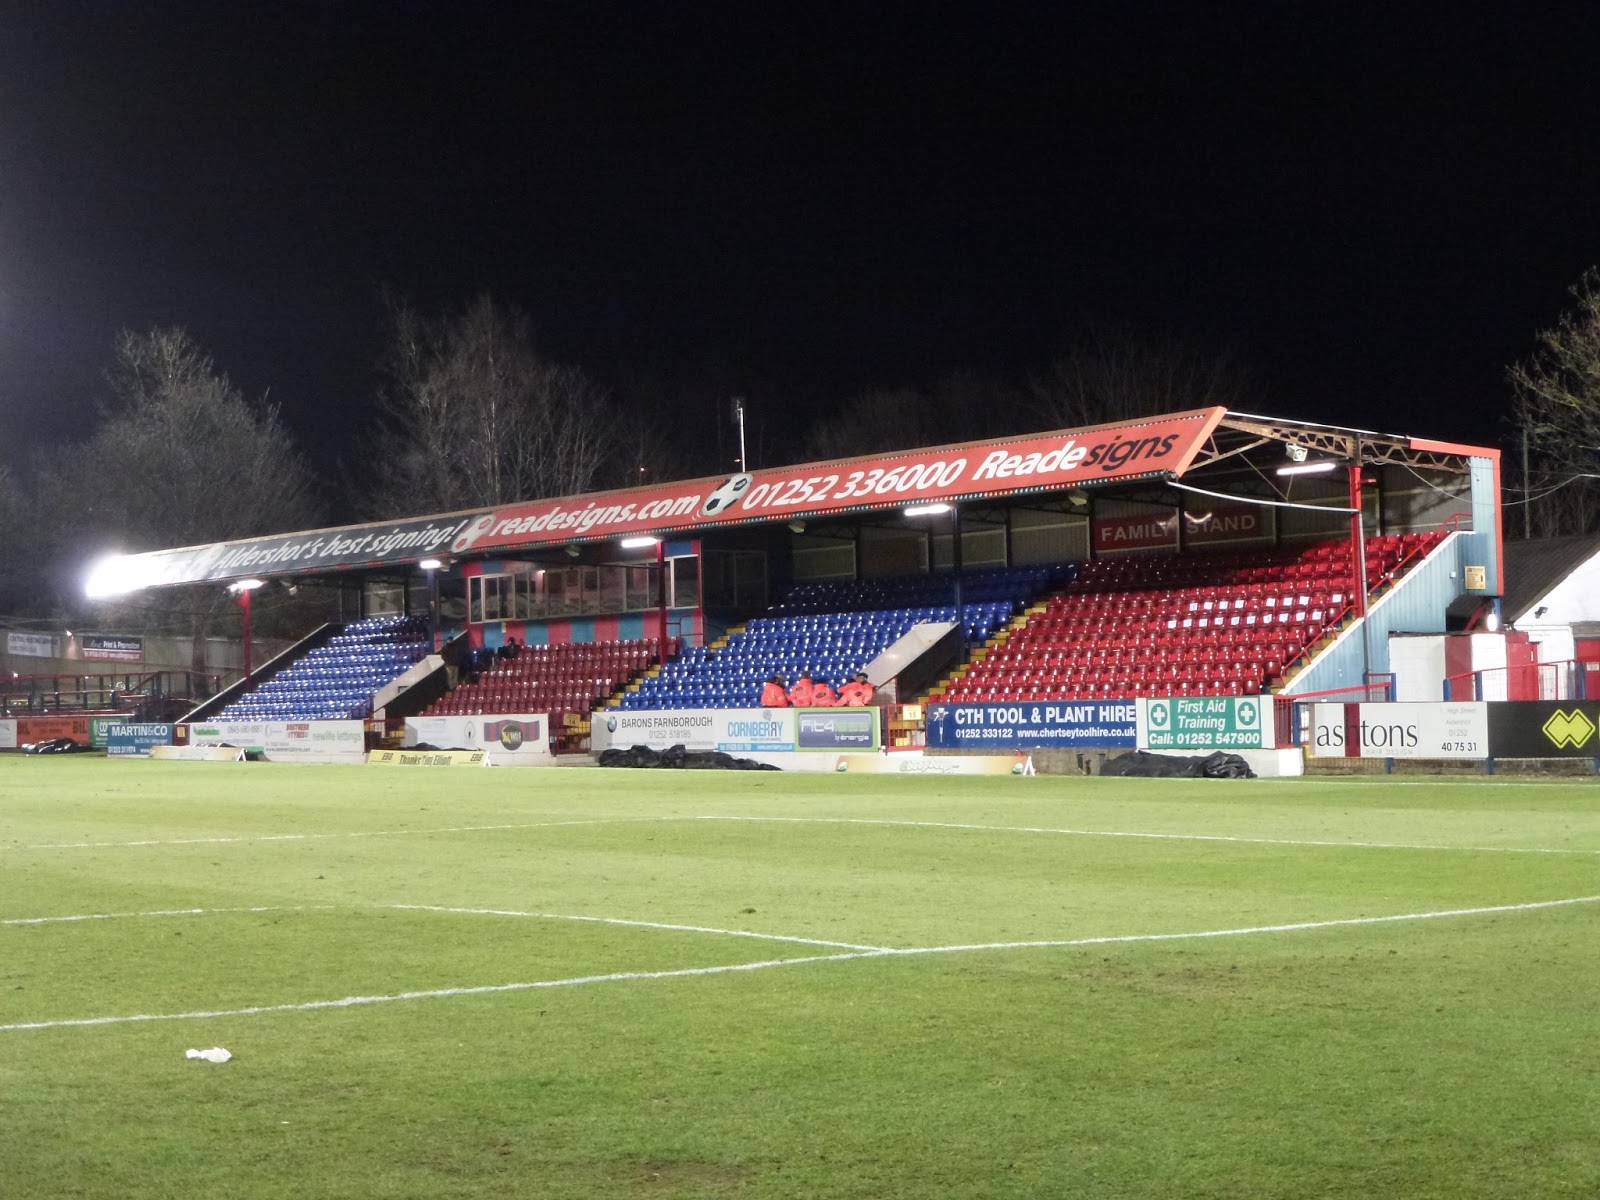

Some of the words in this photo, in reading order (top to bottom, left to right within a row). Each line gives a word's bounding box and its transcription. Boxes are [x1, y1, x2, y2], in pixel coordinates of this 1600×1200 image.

[973, 430, 1180, 482] Readesigns
[742, 475, 839, 510] 01252
[832, 458, 967, 500] 336000
[490, 494, 700, 535] readesigns.com
[1101, 523, 1169, 542] FAMILY
[1186, 514, 1256, 534] STAND
[215, 538, 323, 569] Aldershot's
[322, 532, 373, 556] best
[371, 519, 468, 557] signing!
[1177, 700, 1204, 713] First
[1205, 699, 1226, 712] Aid
[621, 718, 652, 728] BARONS
[653, 716, 713, 728] FARNBOROUGH
[955, 709, 984, 725] CTH
[987, 708, 1028, 724] TOOL
[1031, 708, 1042, 723] &
[1046, 706, 1096, 724] PLANT
[1099, 705, 1136, 722] HIRE
[728, 722, 784, 737] CORNBERRY
[1177, 715, 1226, 731] Training
[111, 725, 167, 736] MARTIN&CO
[649, 730, 666, 738] 01252
[955, 728, 981, 738] 01252
[982, 728, 1013, 738] 333122
[1017, 726, 1136, 740] www.chertseytoolhire.co.uk
[1149, 733, 1174, 744] Call:
[1176, 733, 1212, 744] 01252
[1215, 732, 1259, 744] 547900
[1442, 742, 1452, 752] 40
[1454, 742, 1465, 751] 75
[1468, 742, 1478, 751] 31
[400, 754, 421, 765] Thanks
[422, 754, 432, 765] Tim
